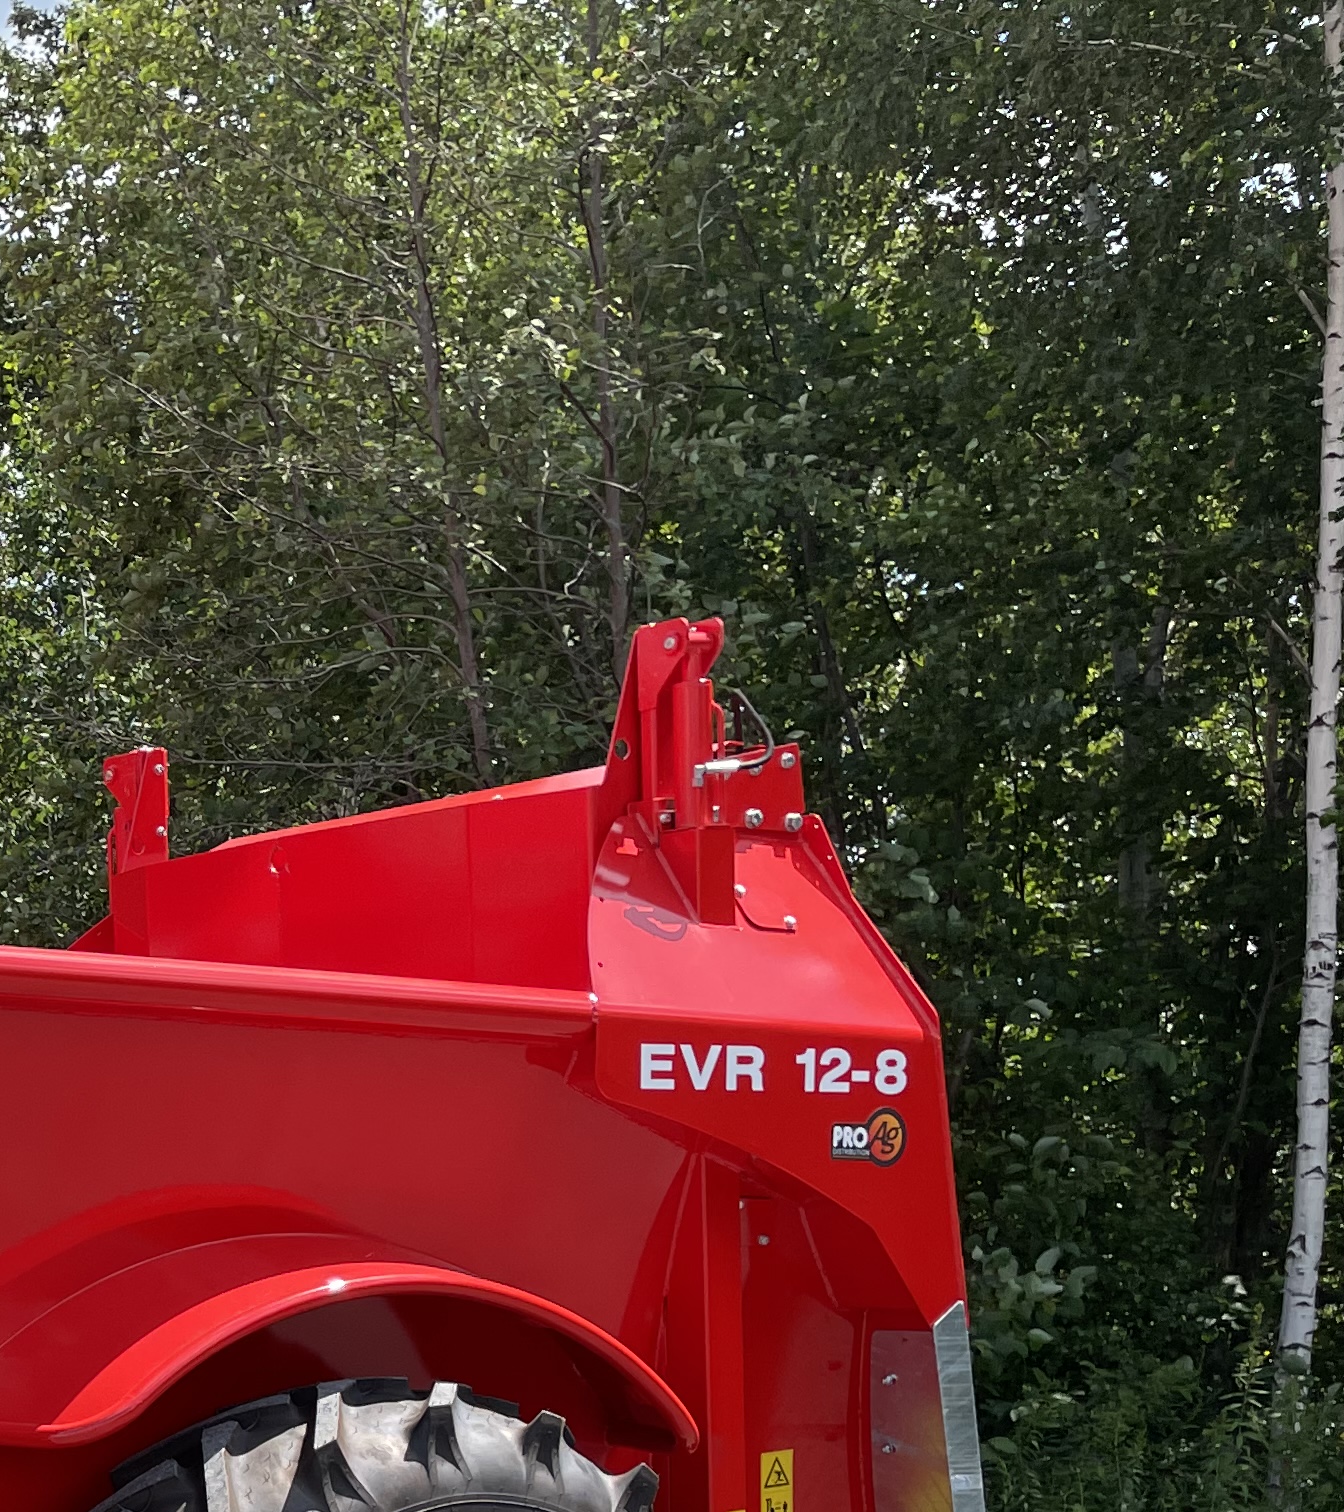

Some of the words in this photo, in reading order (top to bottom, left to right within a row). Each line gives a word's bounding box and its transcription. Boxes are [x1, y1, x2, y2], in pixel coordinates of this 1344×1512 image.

[640, 1043, 765, 1092] EVR
[795, 1047, 908, 1095] 12-8
[833, 1125, 869, 1148] PRO
[869, 1121, 902, 1154] Ag
